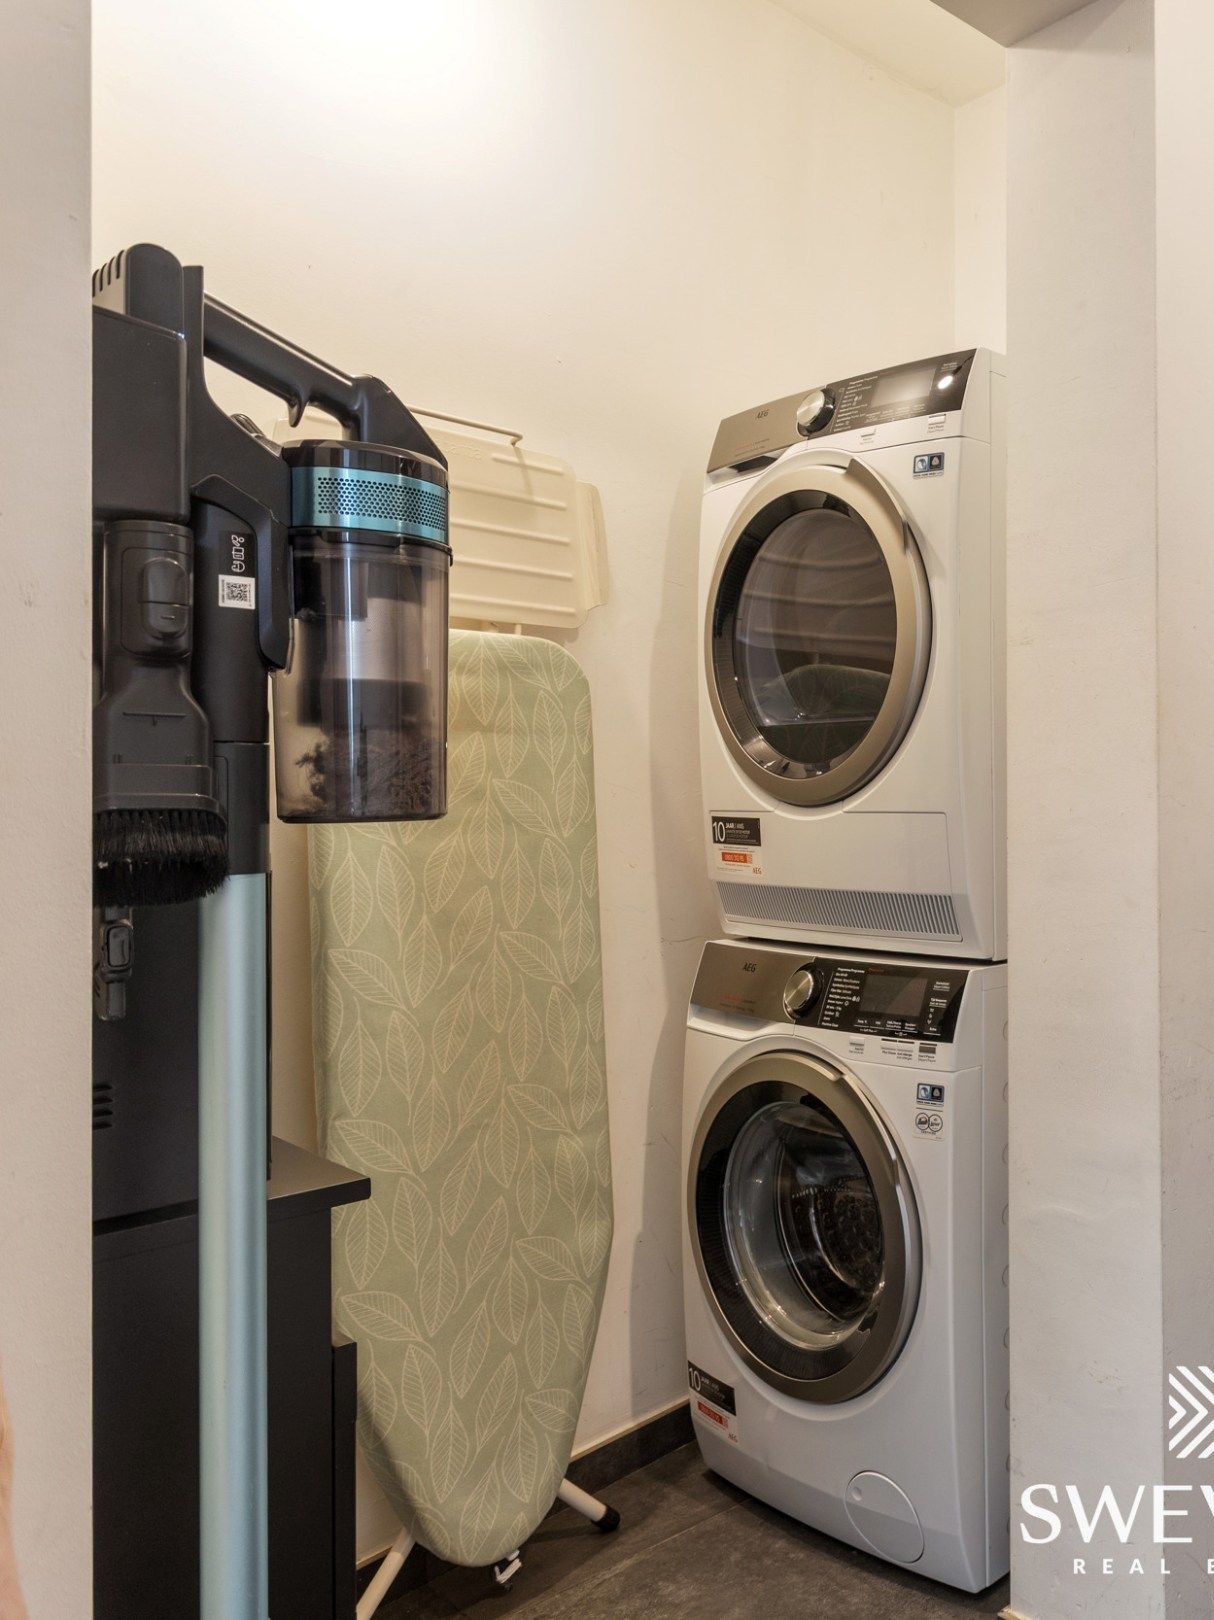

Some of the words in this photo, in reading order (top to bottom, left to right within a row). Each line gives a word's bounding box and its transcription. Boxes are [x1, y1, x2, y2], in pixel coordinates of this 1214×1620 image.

[712, 821, 726, 842] 10
[742, 962, 758, 973] AEG
[688, 1367, 701, 1392] 10
